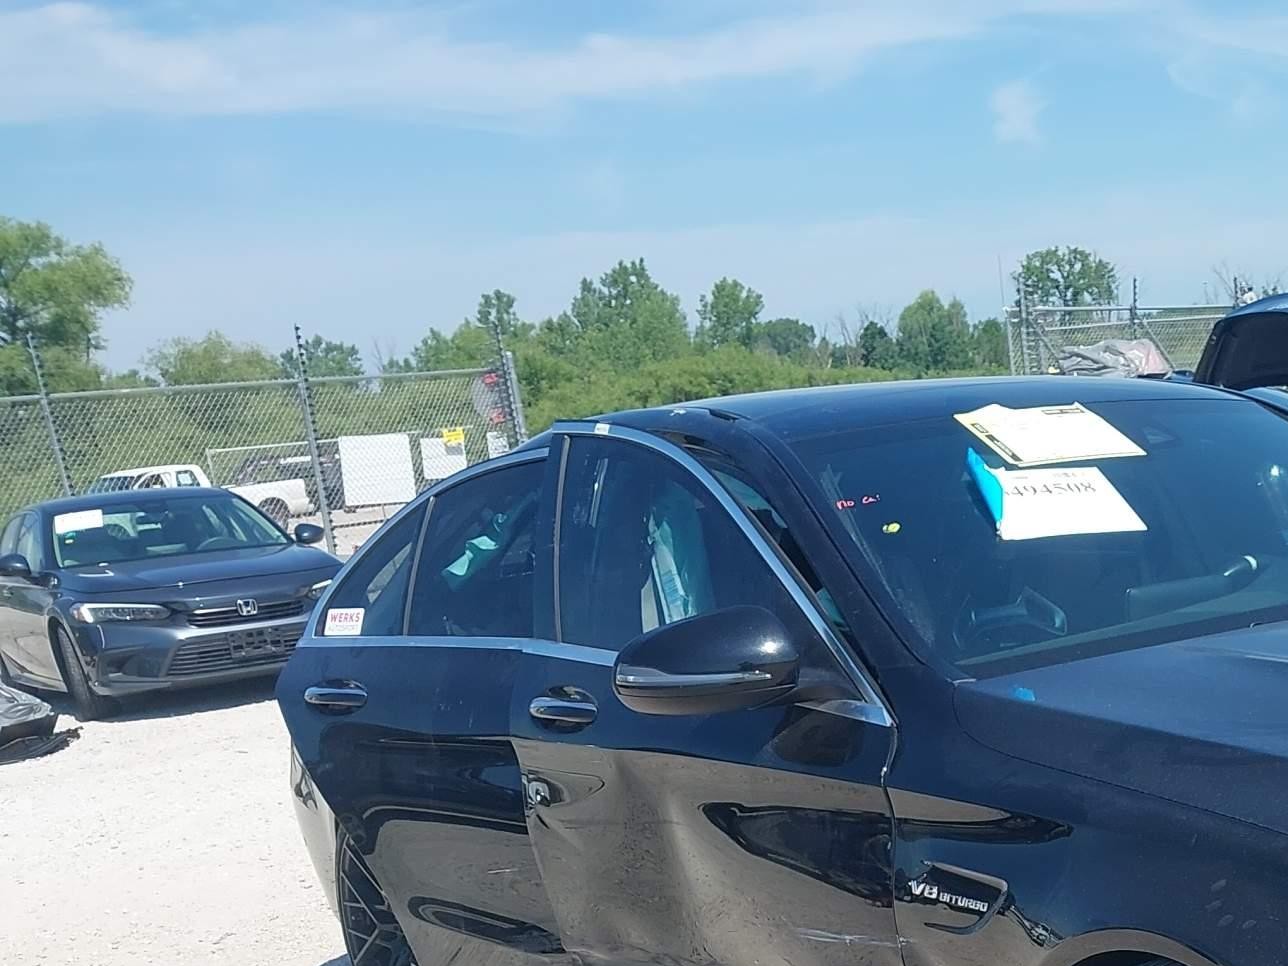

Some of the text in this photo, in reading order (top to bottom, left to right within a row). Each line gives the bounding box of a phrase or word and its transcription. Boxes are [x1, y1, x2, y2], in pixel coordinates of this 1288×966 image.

[330, 612, 361, 623] WERKS
[908, 880, 989, 913] V8 BITURBO
